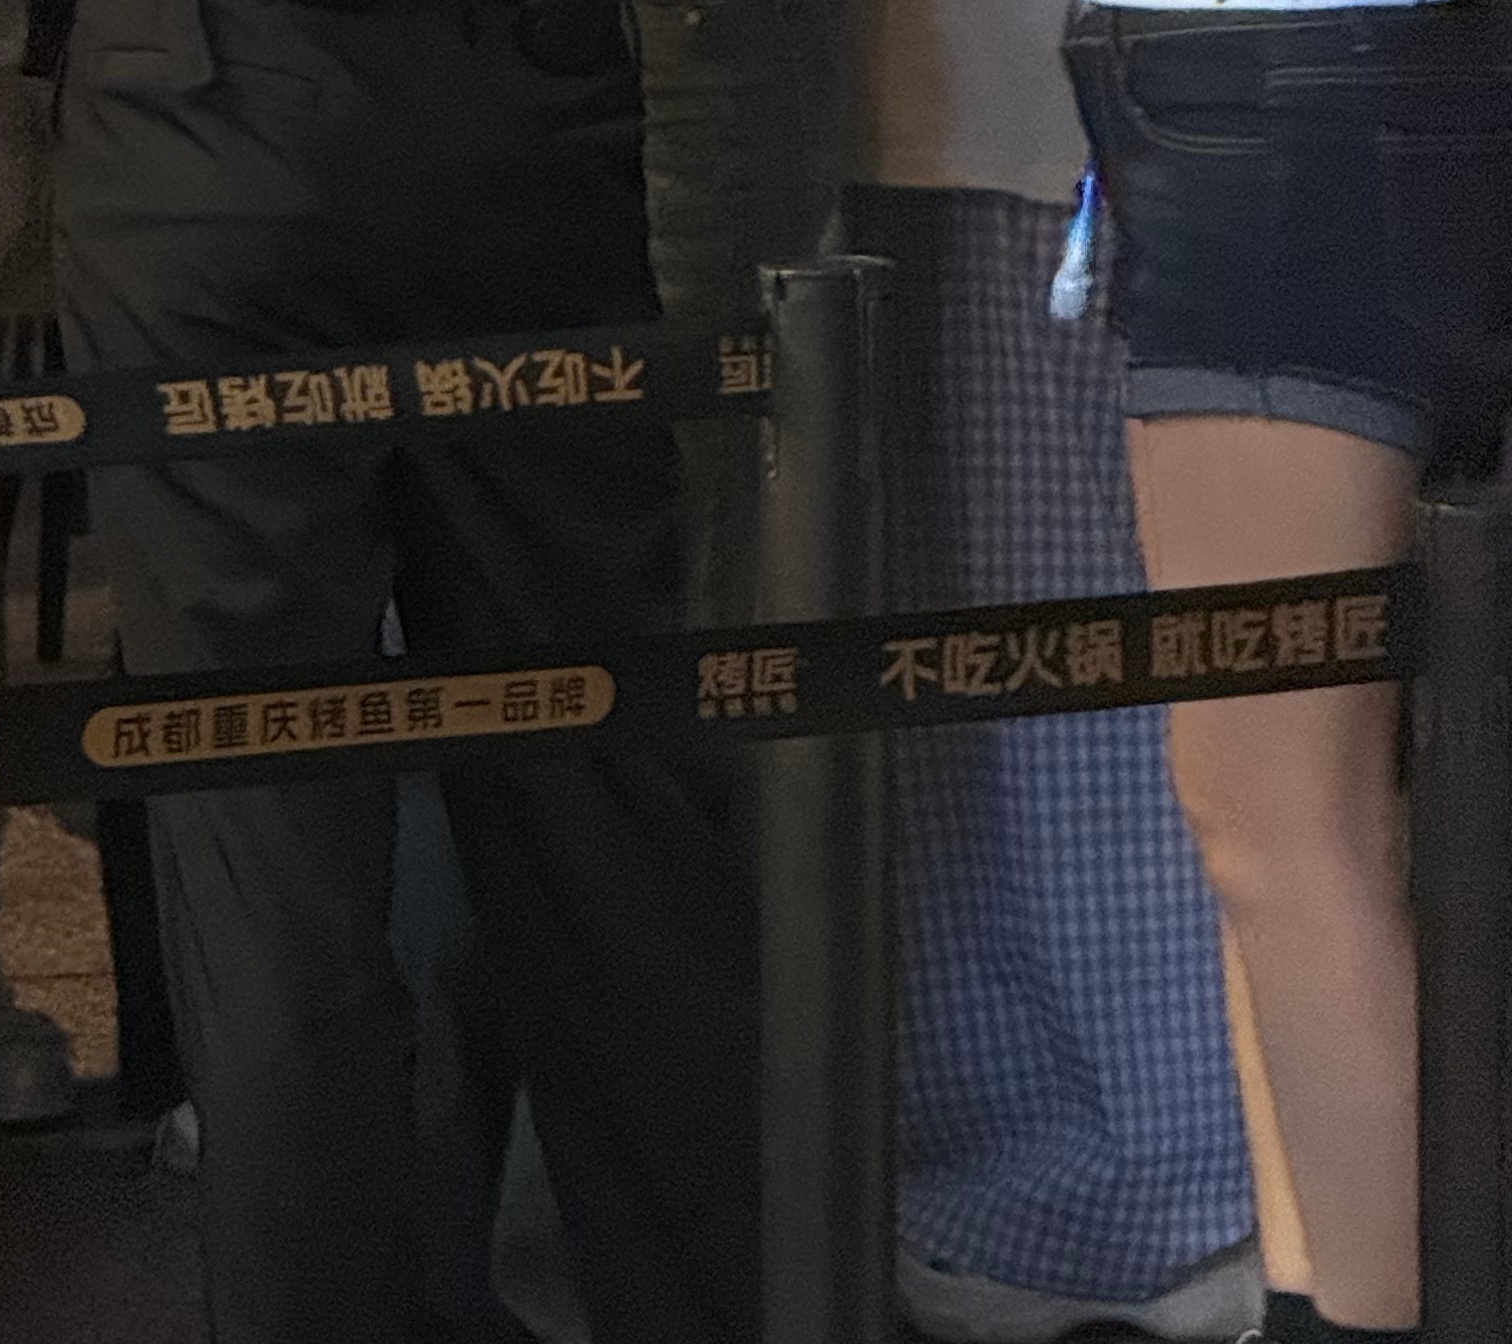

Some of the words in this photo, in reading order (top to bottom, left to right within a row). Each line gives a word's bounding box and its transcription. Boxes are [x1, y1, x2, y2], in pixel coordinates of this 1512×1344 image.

[156, 364, 394, 435] 就吃烤匠
[416, 346, 644, 416] 不吃火锅
[698, 648, 800, 700] 烤匠
[881, 620, 1125, 702] 不吃火锅
[1150, 595, 1390, 679] 就吃烤匠
[112, 677, 589, 760] 成都重庆烤鱼第一品牌
